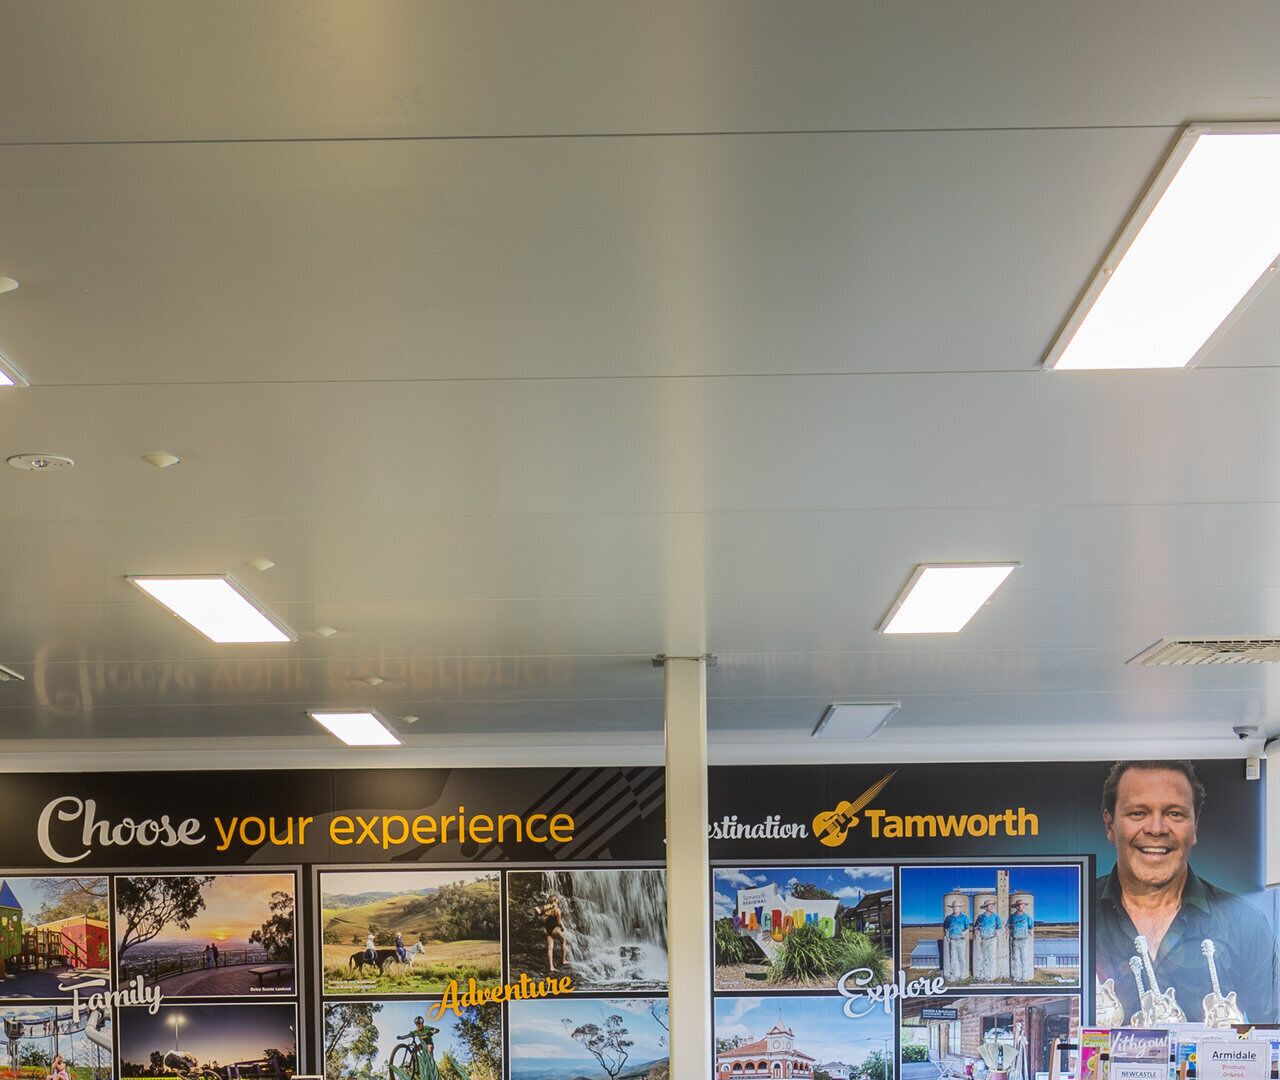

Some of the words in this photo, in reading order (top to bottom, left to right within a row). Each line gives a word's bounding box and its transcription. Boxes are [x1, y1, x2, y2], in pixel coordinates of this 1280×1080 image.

[37, 796, 206, 863] Choose
[215, 815, 314, 851] your
[329, 807, 575, 849] experience
[706, 815, 808, 840] estination
[864, 807, 1039, 838] Tamworth
[56, 975, 164, 1024] Family
[426, 972, 576, 1022] Adventure
[837, 967, 949, 1019] Explore
[1212, 1050, 1257, 1060] Armidale
